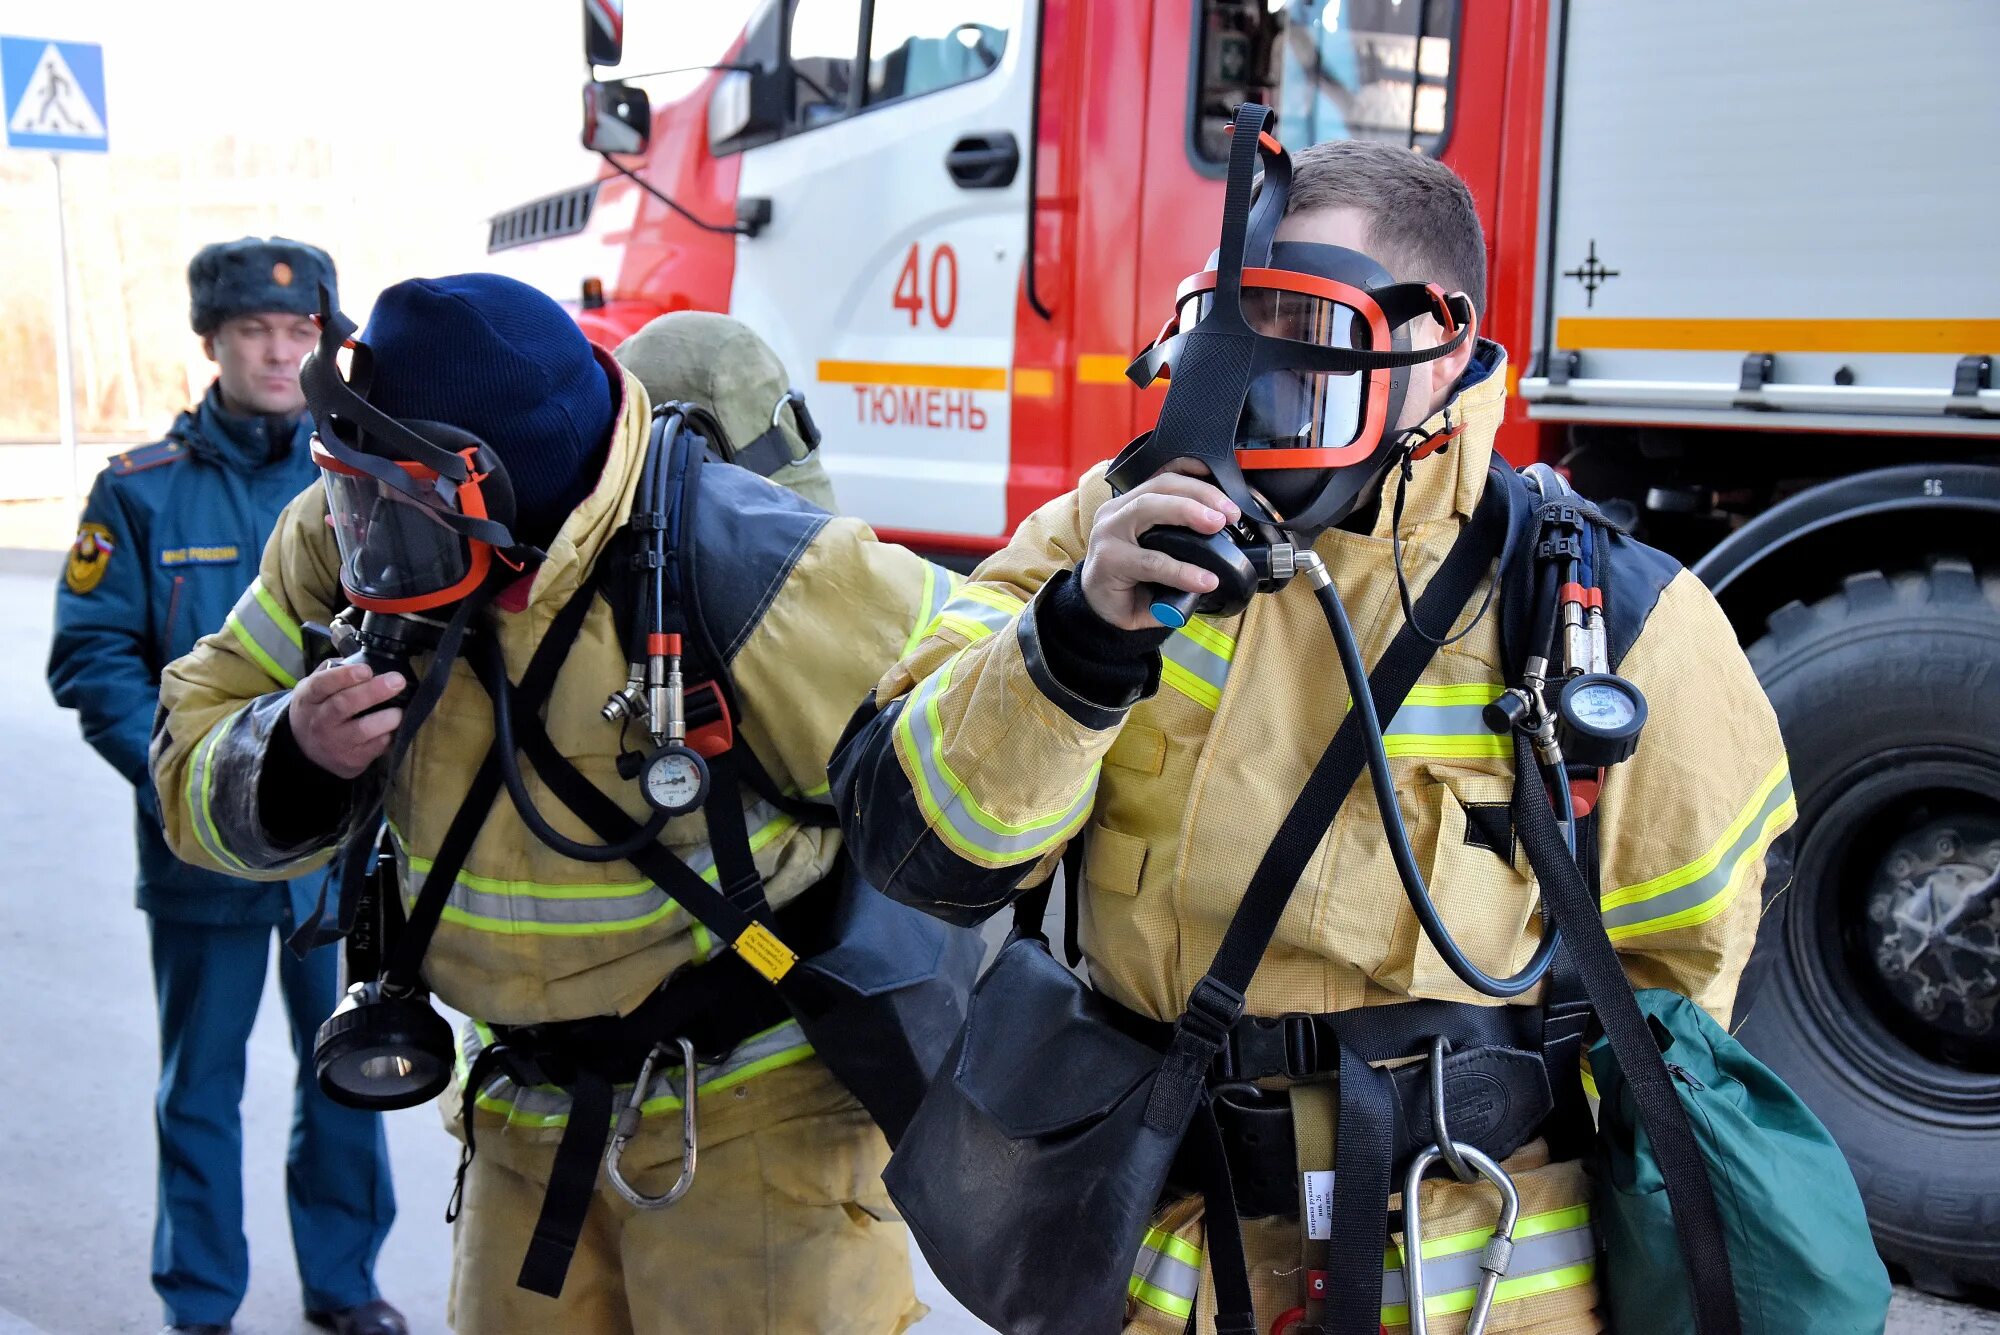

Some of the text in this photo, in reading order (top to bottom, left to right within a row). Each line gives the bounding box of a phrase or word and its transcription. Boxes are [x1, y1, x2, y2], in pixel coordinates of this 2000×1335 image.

[893, 242, 958, 329] 40
[854, 385, 987, 431] ТЮМЕНЬ
[1316, 1194, 1322, 1202] 26
